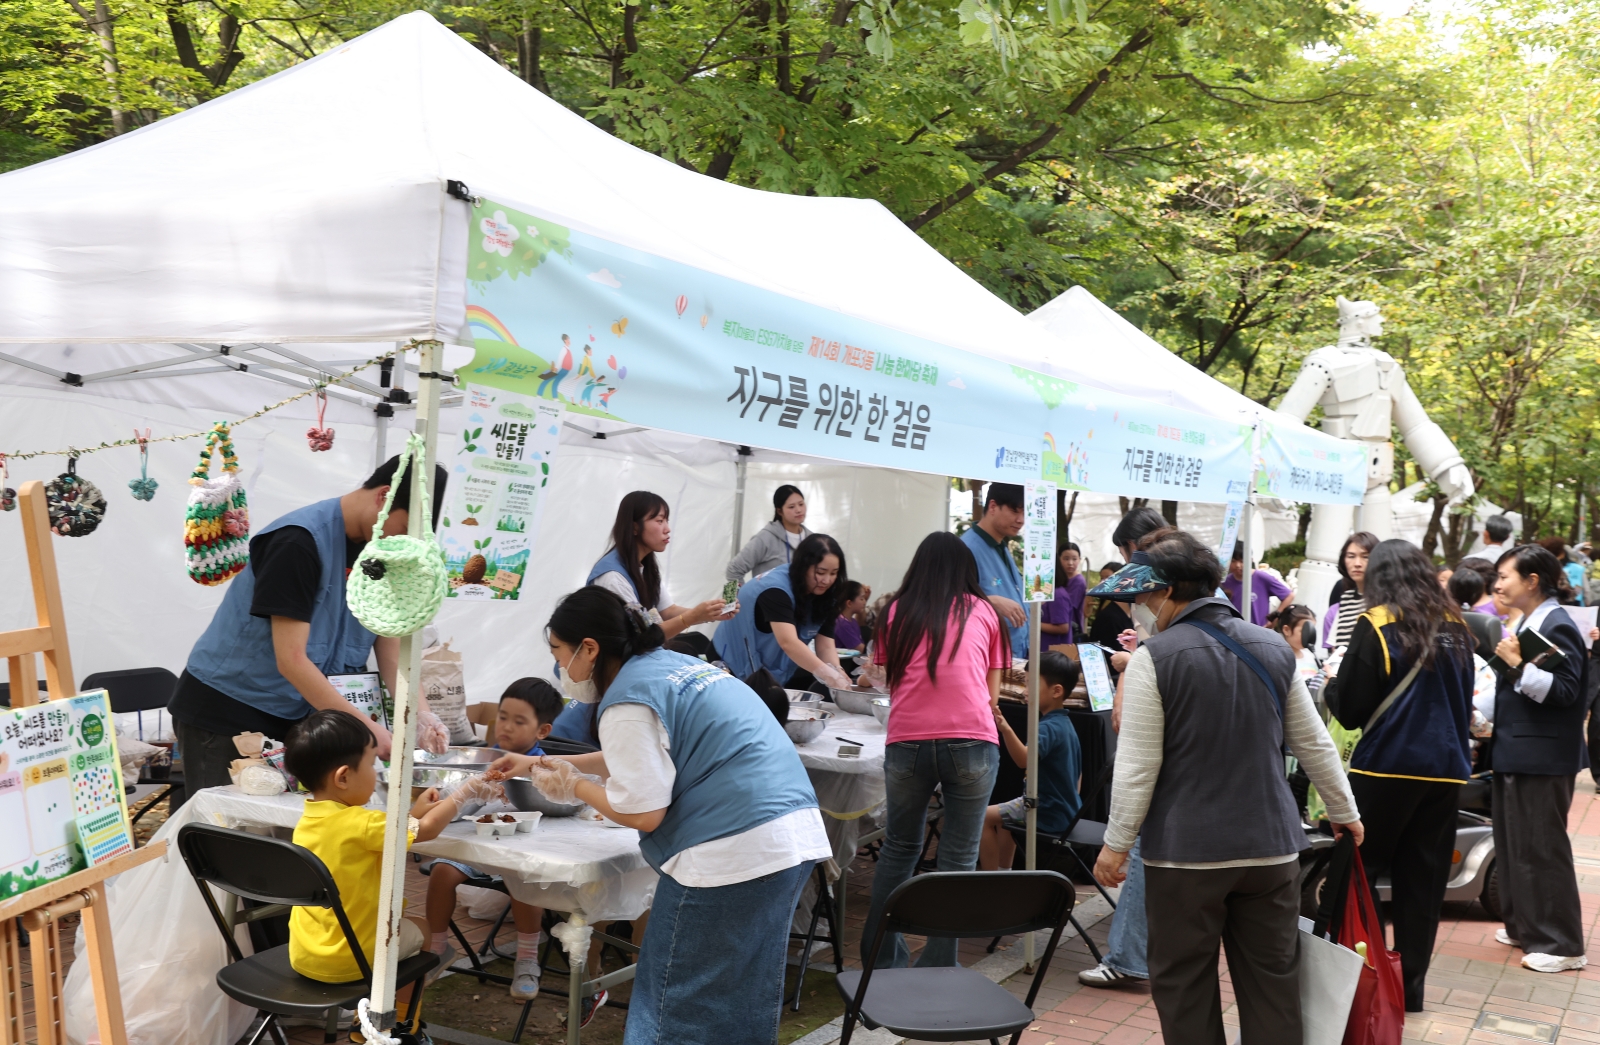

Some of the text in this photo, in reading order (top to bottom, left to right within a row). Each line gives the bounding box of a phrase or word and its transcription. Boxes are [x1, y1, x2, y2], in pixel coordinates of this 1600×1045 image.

[504, 361, 538, 374] 강남구
[757, 328, 792, 351] ESG가치를
[807, 335, 841, 362] 제14회
[842, 344, 875, 371] 개포3동
[875, 352, 895, 376] 나눔
[895, 356, 922, 382] 한마당
[922, 363, 938, 386] 축제
[727, 366, 931, 450] 지구를 위한 한 걸음
[490, 422, 529, 446] 씨드볼
[495, 442, 524, 460] 만들기
[1123, 447, 1154, 483] 지구를
[1155, 451, 1175, 485] 위한
[1174, 454, 1185, 486] 한
[1185, 457, 1203, 488] 걸음
[343, 691, 374, 703] 드볼 만들기
[5, 709, 70, 740] 오늘, 씨드볼 만들기
[18, 728, 64, 749] 어떠셨나요?
